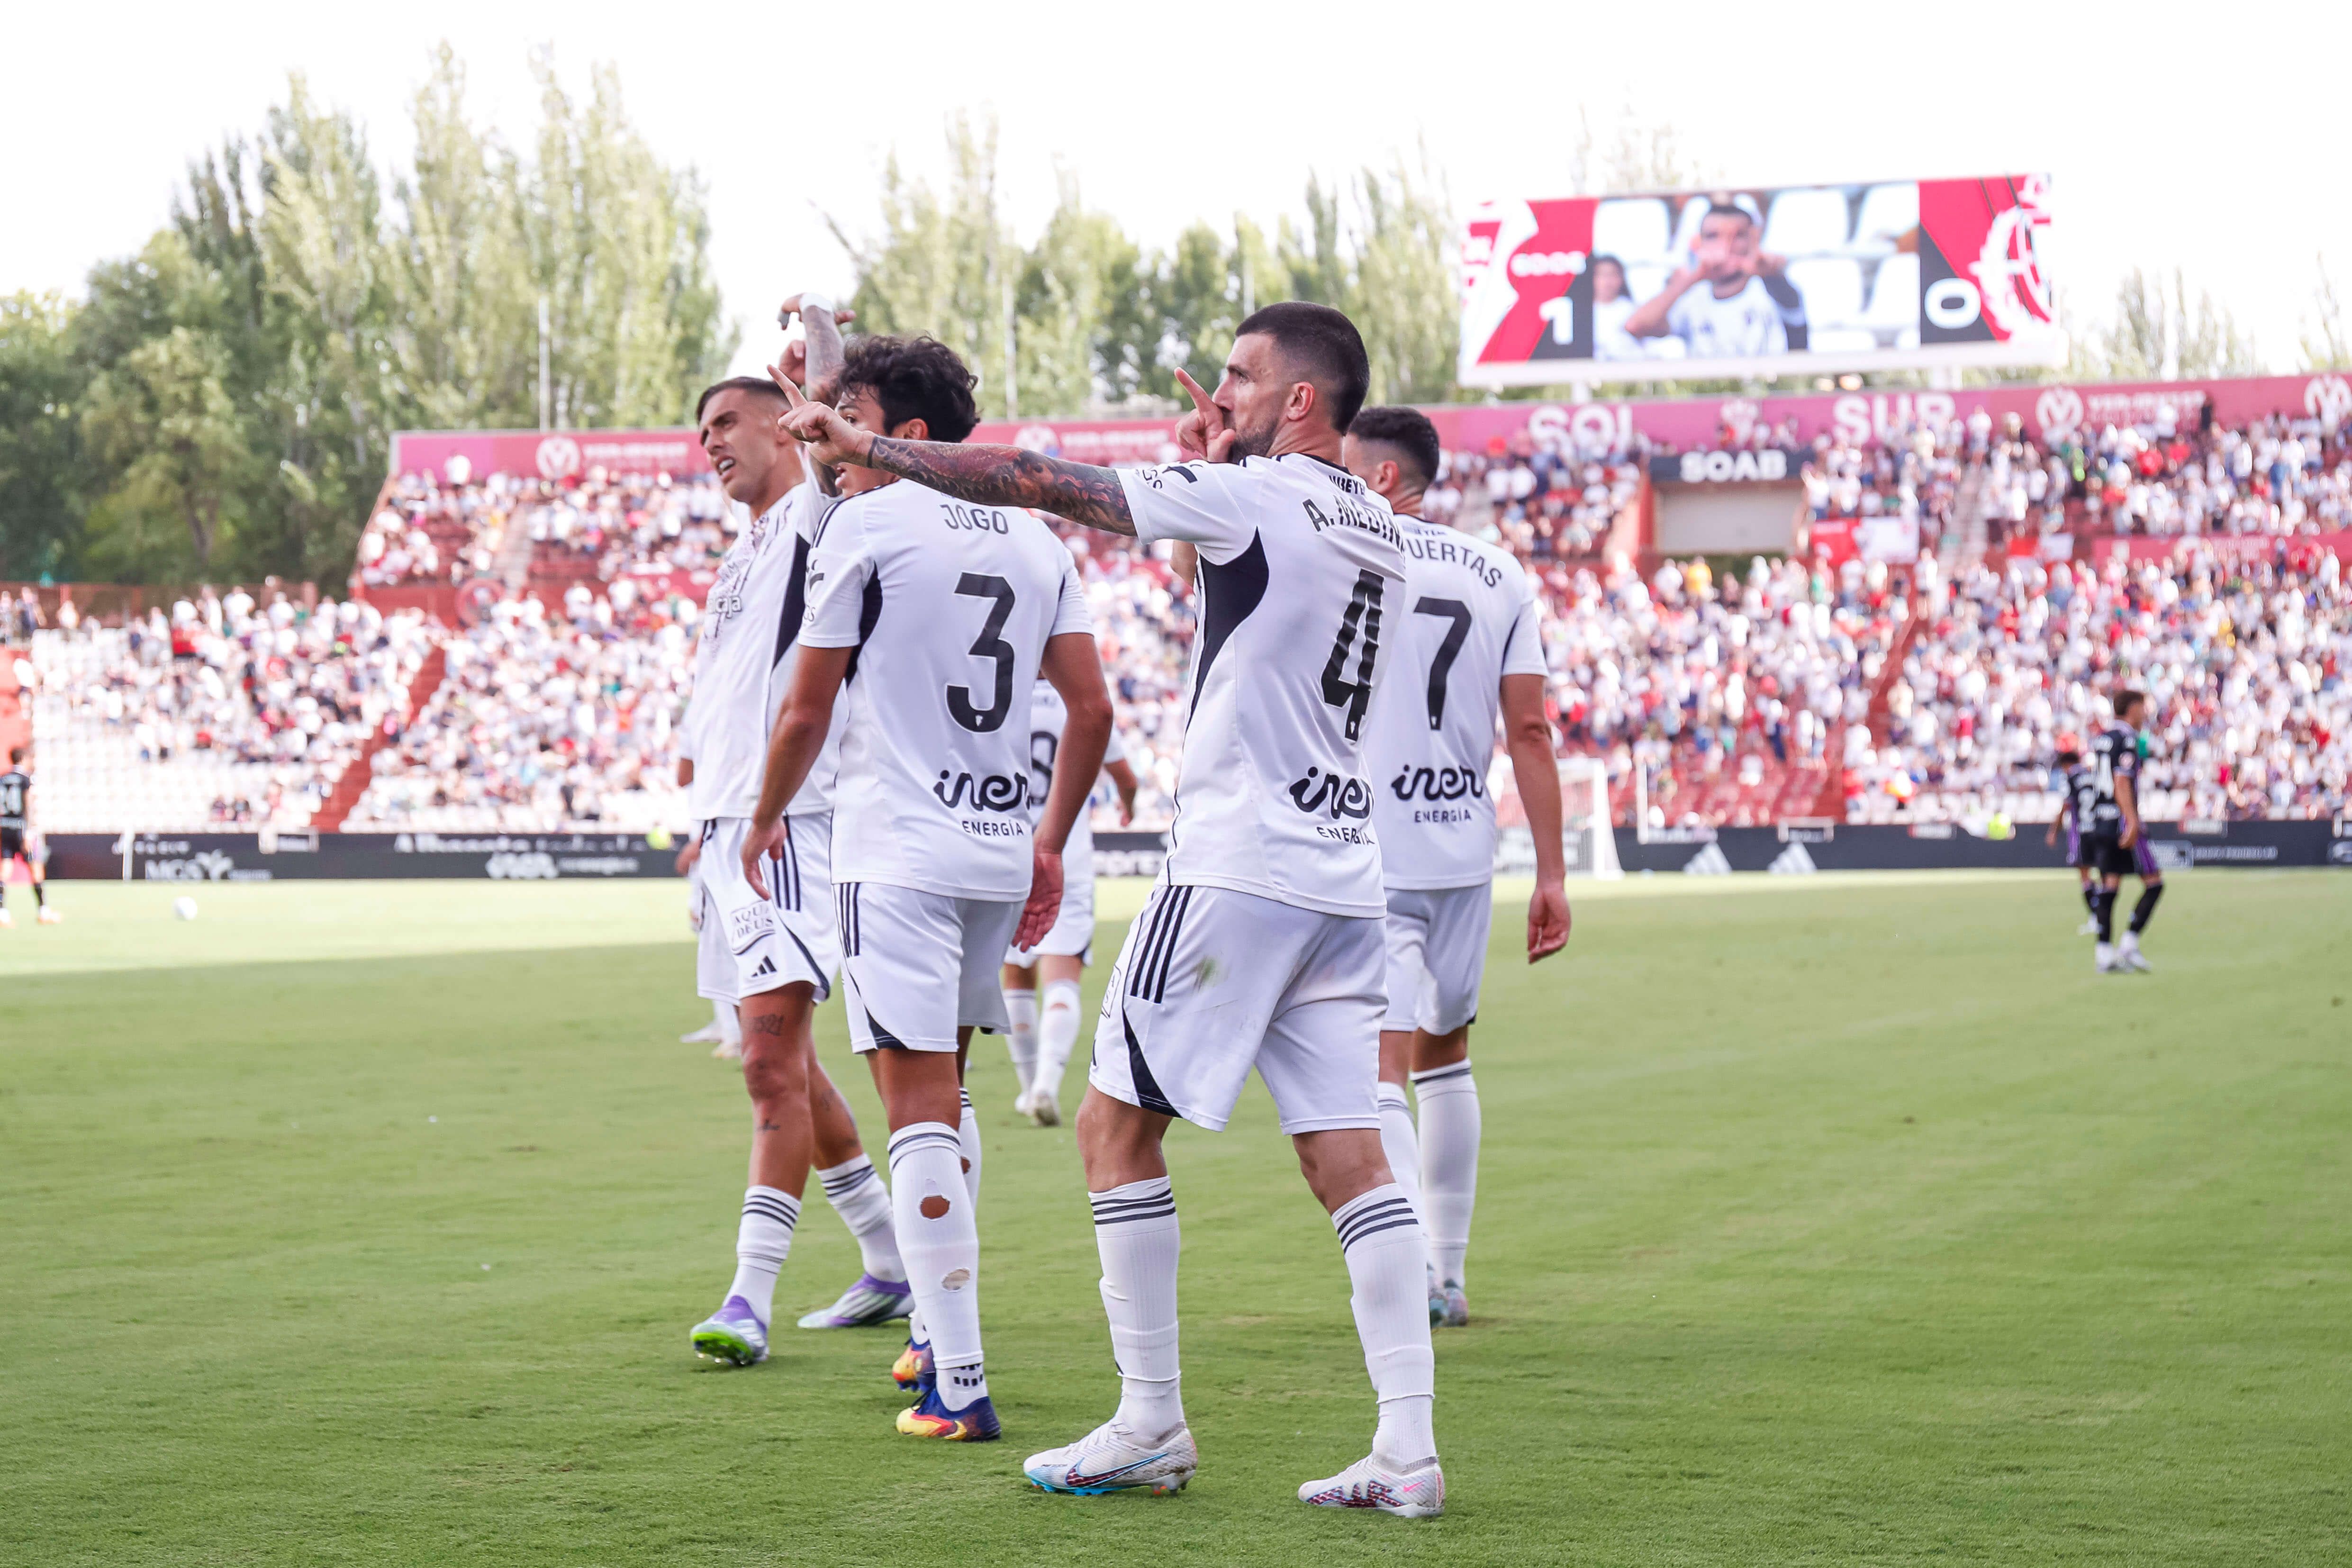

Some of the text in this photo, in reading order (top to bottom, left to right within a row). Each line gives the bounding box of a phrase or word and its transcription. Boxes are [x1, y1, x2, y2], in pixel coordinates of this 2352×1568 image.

[1539, 296, 1574, 345] 1
[1924, 277, 1981, 329] 0
[940, 504, 1009, 535] JOGO
[1406, 538, 1502, 588] UERTAS
[947, 572, 1015, 732] 3
[1321, 568, 1384, 743] 4
[1413, 596, 1472, 730] 7
[1391, 764, 1483, 800] iner
[962, 820, 1024, 835] ENERGÍA
